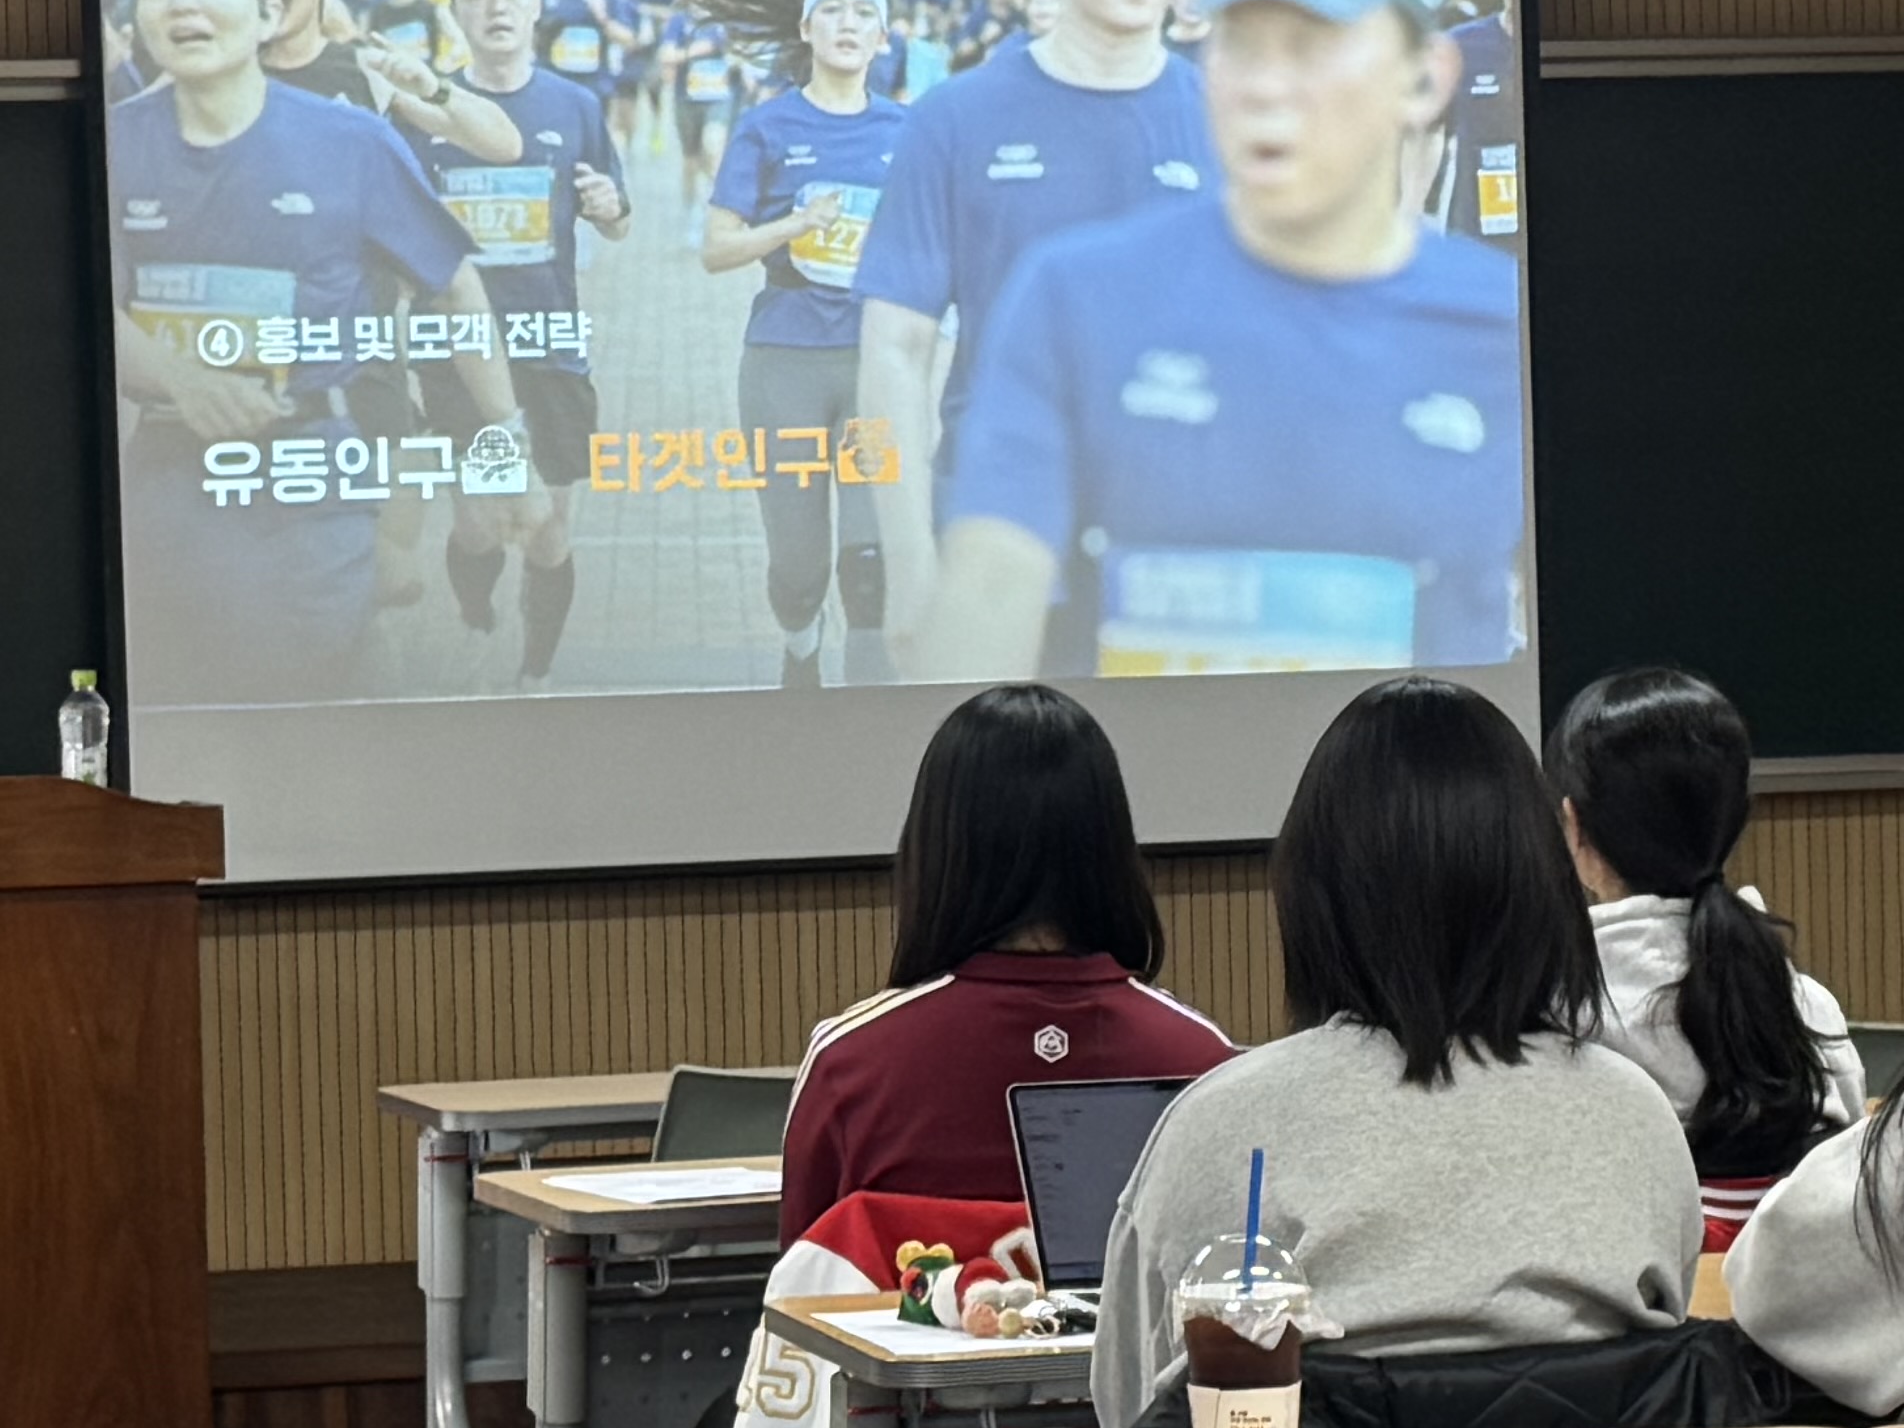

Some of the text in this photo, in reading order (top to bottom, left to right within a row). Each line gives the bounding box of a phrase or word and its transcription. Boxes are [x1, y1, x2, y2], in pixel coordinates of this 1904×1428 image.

[255, 315, 343, 364] 홍보
[353, 315, 396, 361] 및
[408, 313, 492, 360] 모객
[505, 311, 593, 358] 전략
[202, 427, 831, 507] 유동인구 타겟인구
